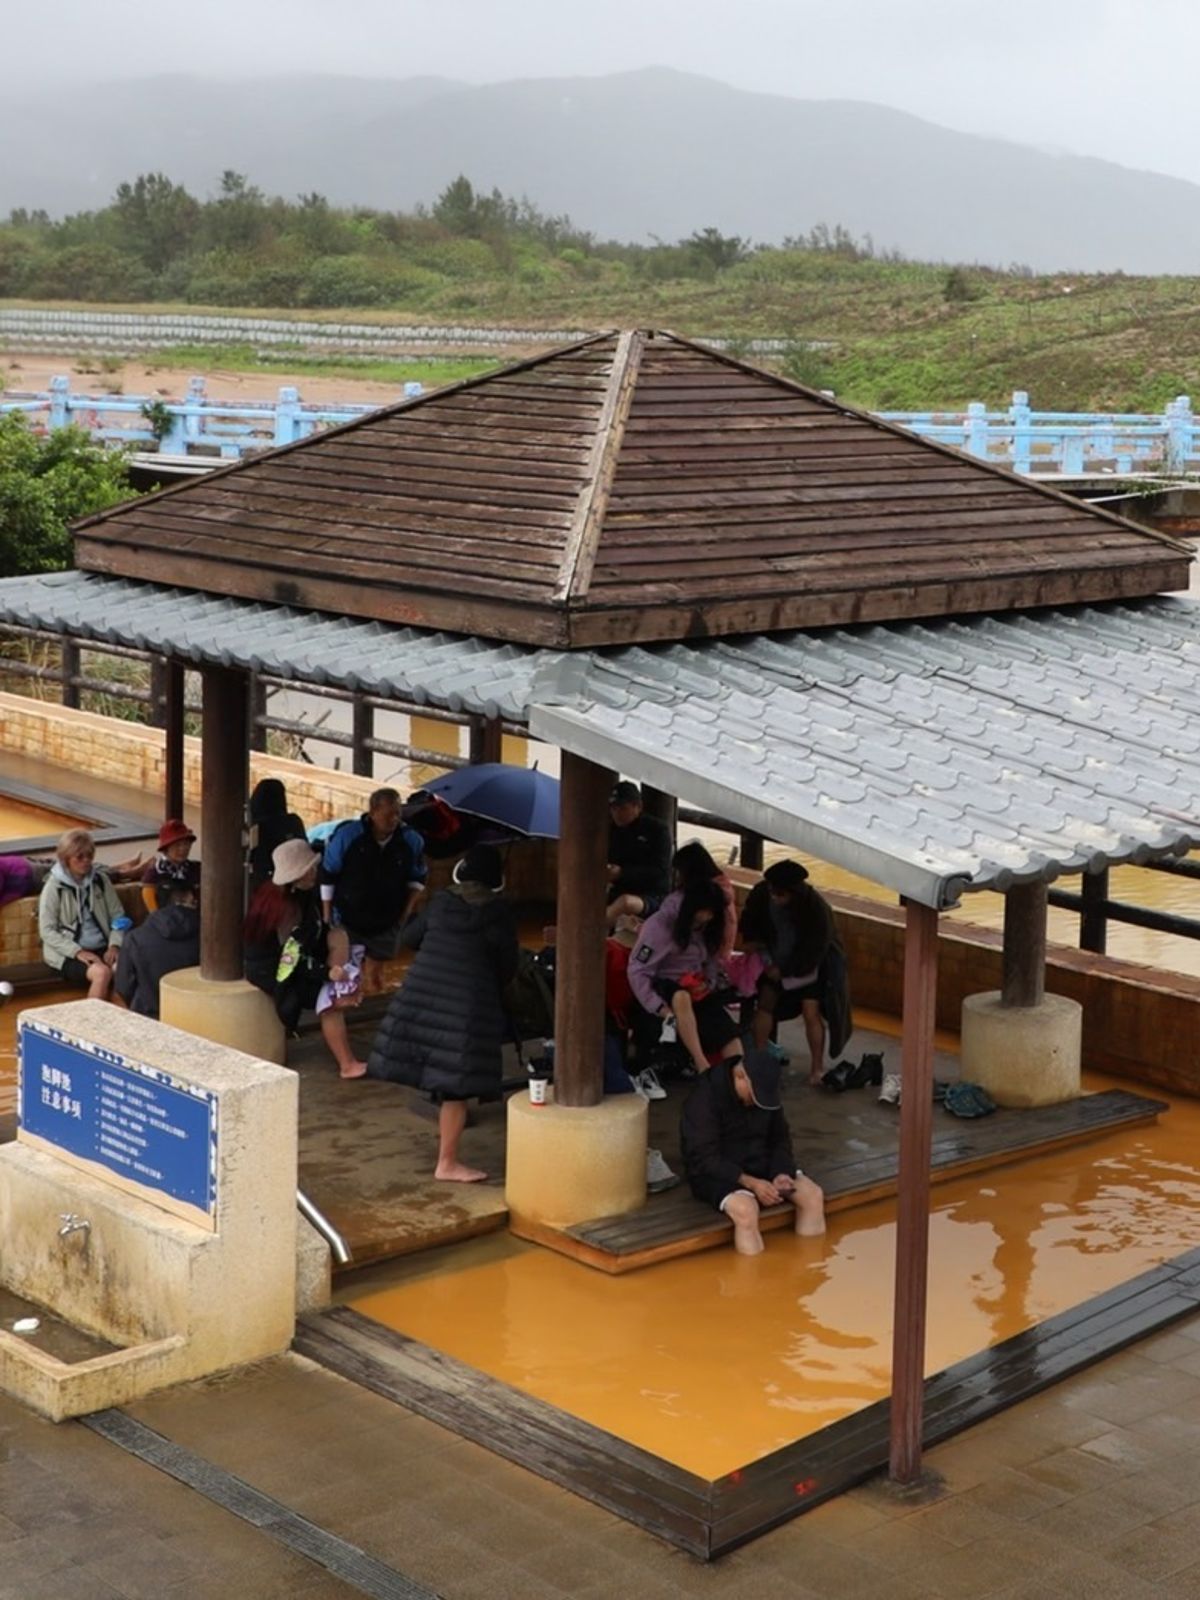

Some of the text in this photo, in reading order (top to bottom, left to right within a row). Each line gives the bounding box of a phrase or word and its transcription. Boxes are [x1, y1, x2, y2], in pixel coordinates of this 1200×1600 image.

[42, 1064, 72, 1092] 泡腳池
[42, 1085, 82, 1120] 注意事項
